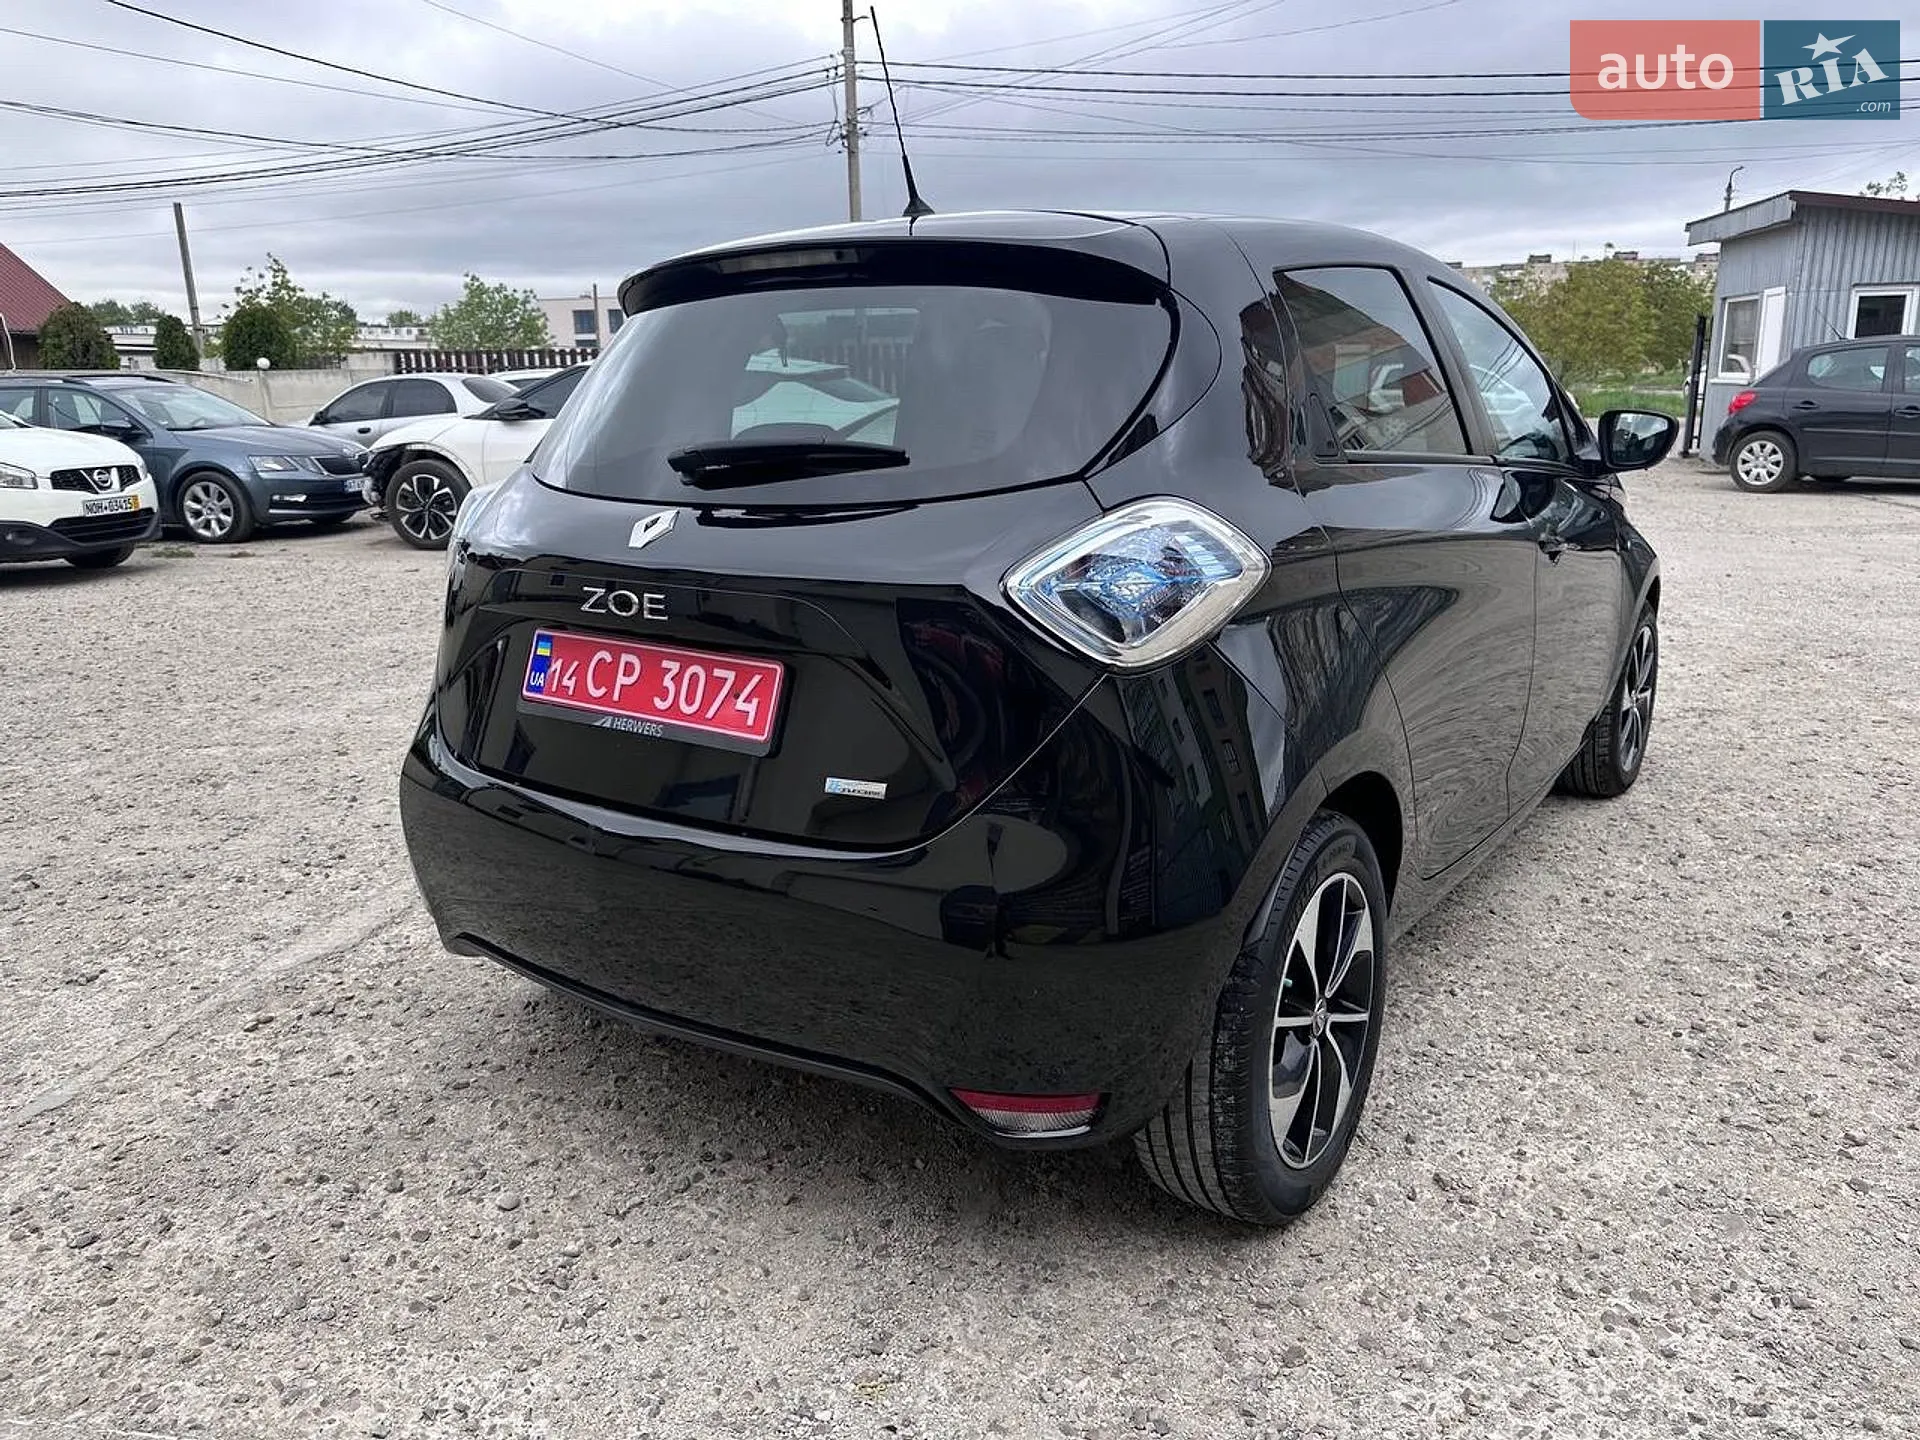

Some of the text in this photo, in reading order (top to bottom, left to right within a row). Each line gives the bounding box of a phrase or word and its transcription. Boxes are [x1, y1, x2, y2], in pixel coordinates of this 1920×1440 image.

[580, 586, 669, 621] ZOE
[529, 670, 545, 688] UA
[548, 650, 763, 727] 14 CP 3074
[613, 717, 664, 738] HERWERS
